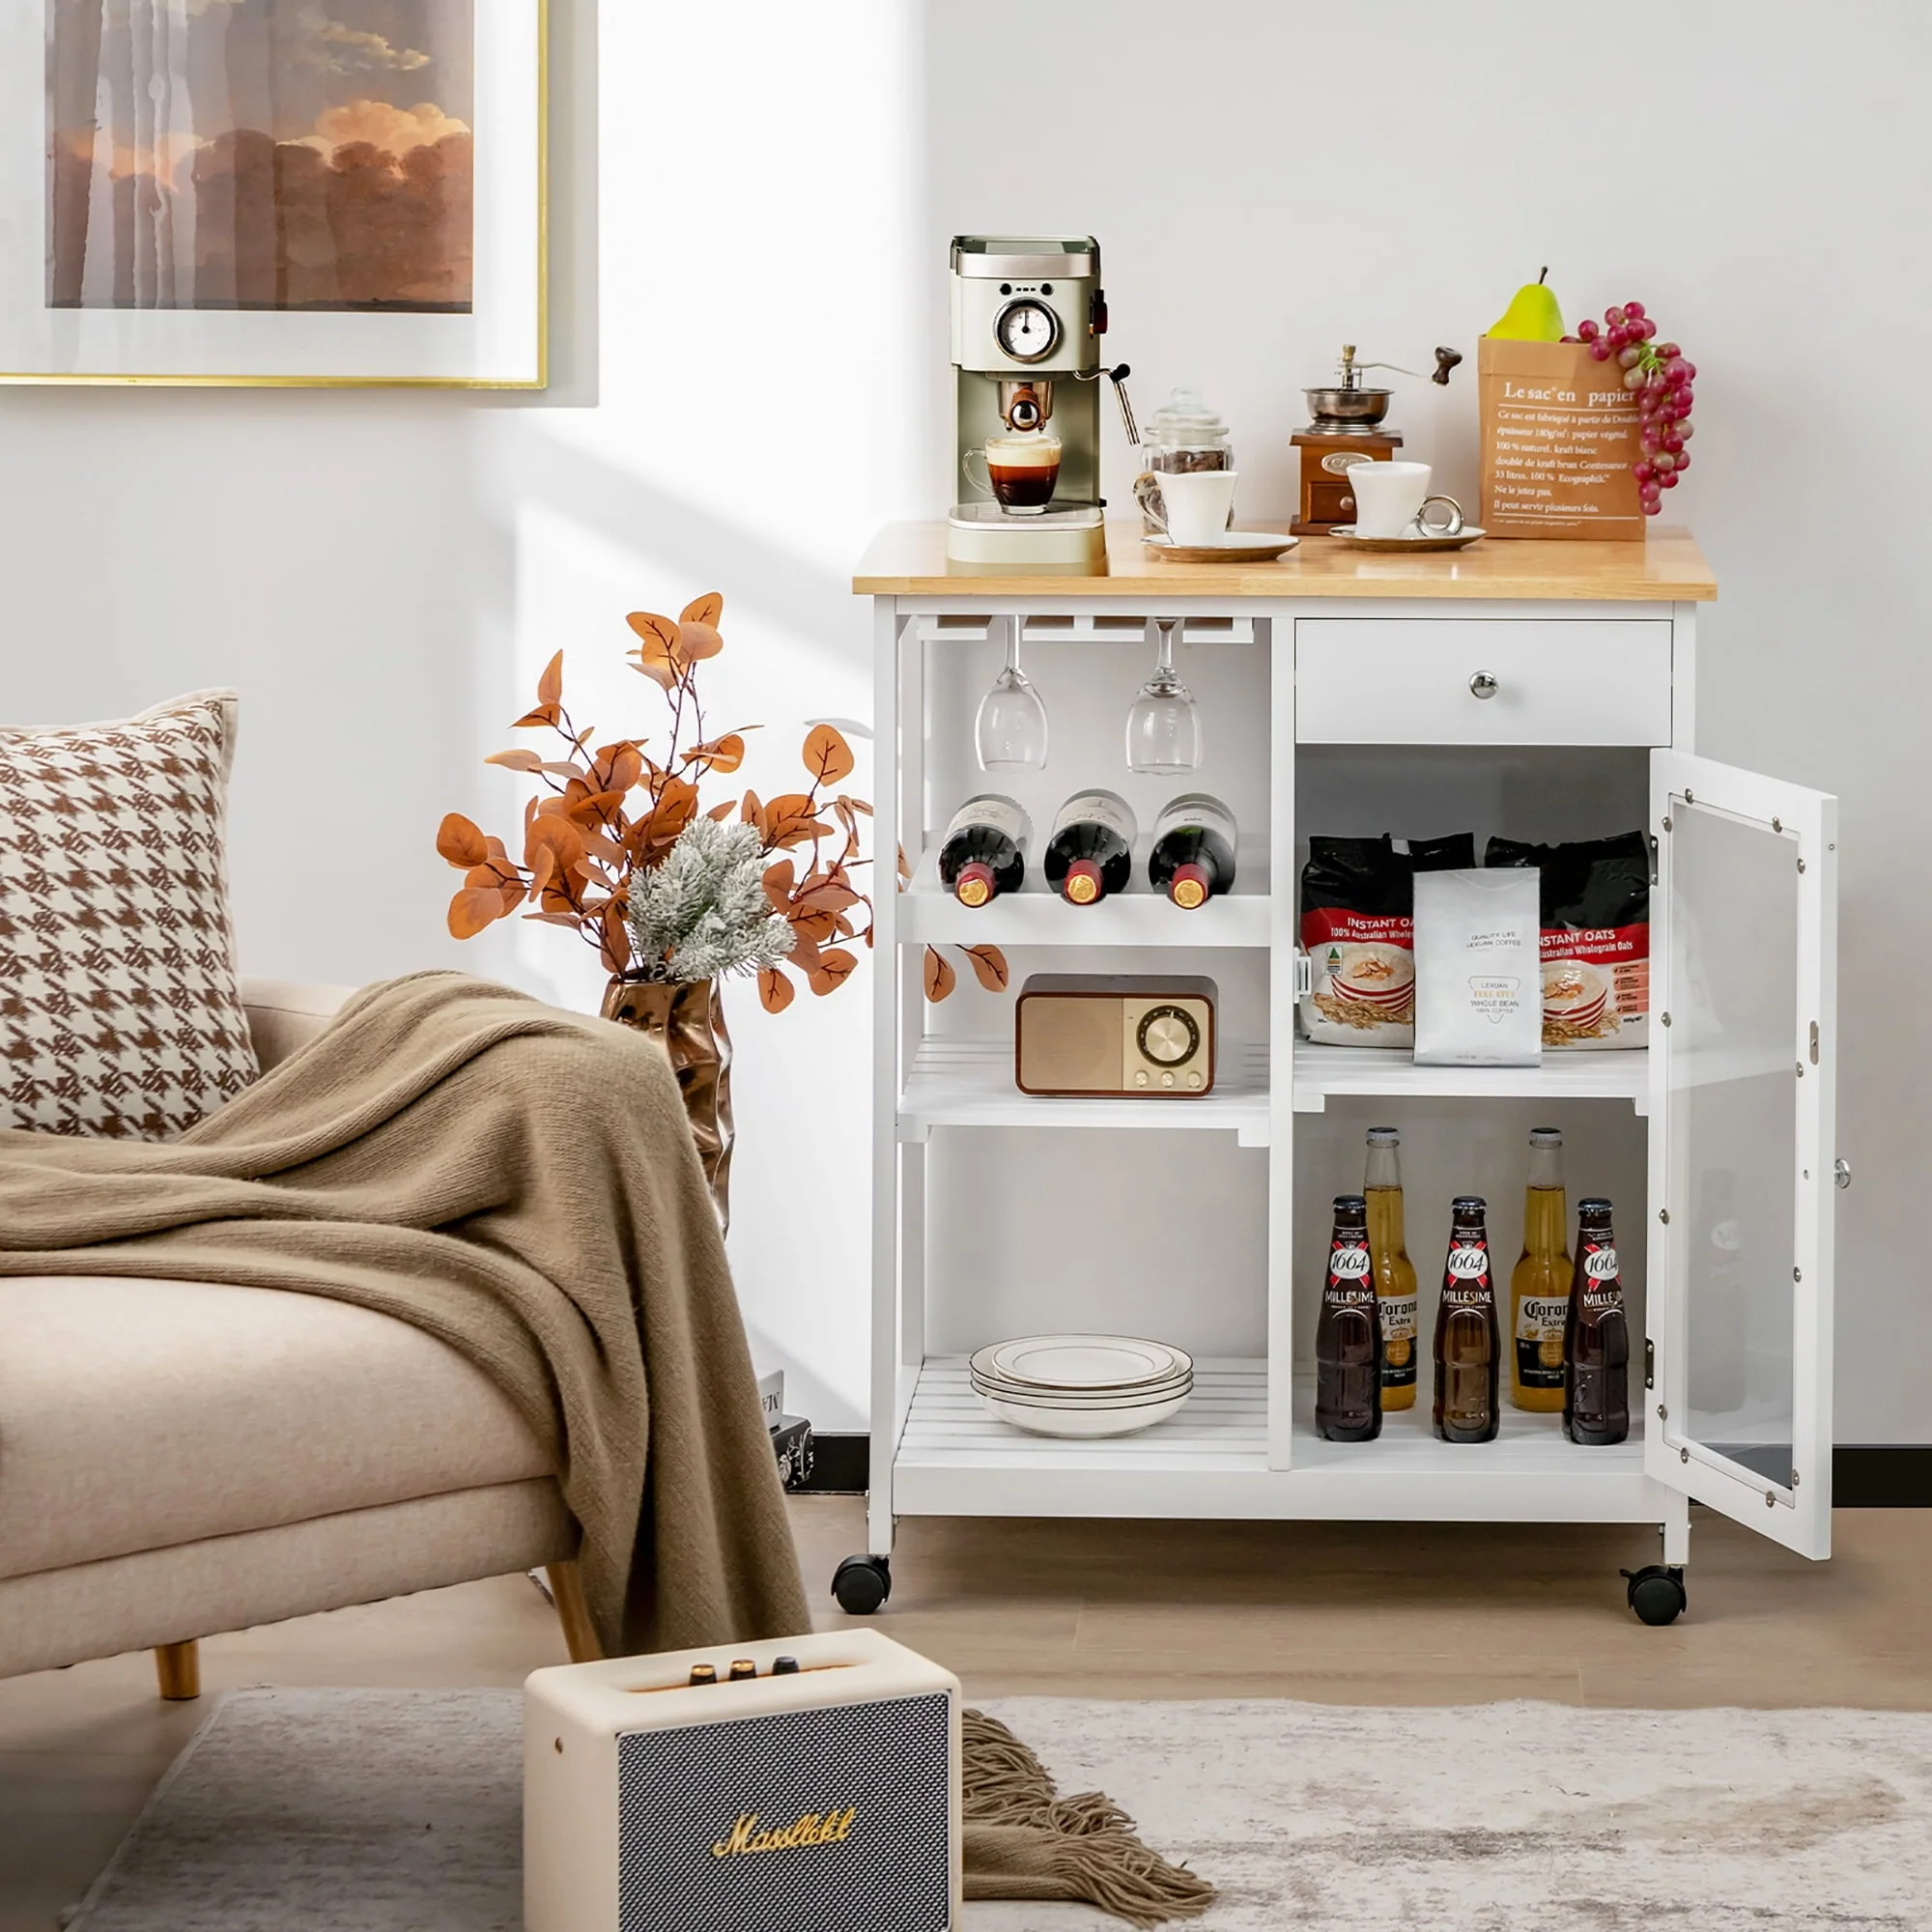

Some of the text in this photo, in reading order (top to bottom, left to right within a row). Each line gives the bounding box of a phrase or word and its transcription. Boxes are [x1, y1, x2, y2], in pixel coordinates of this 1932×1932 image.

[1504, 382, 1525, 398] Le
[1557, 389, 1576, 401] en
[1588, 388, 1635, 407] papier
[1602, 414, 1611, 423] de
[1524, 459, 1536, 468] de
[1347, 917, 1397, 929] INSTANT
[1330, 927, 1350, 937] 100%
[1584, 929, 1616, 942] OATS
[1332, 1252, 1367, 1271] 1664
[1449, 1252, 1484, 1271] 1664
